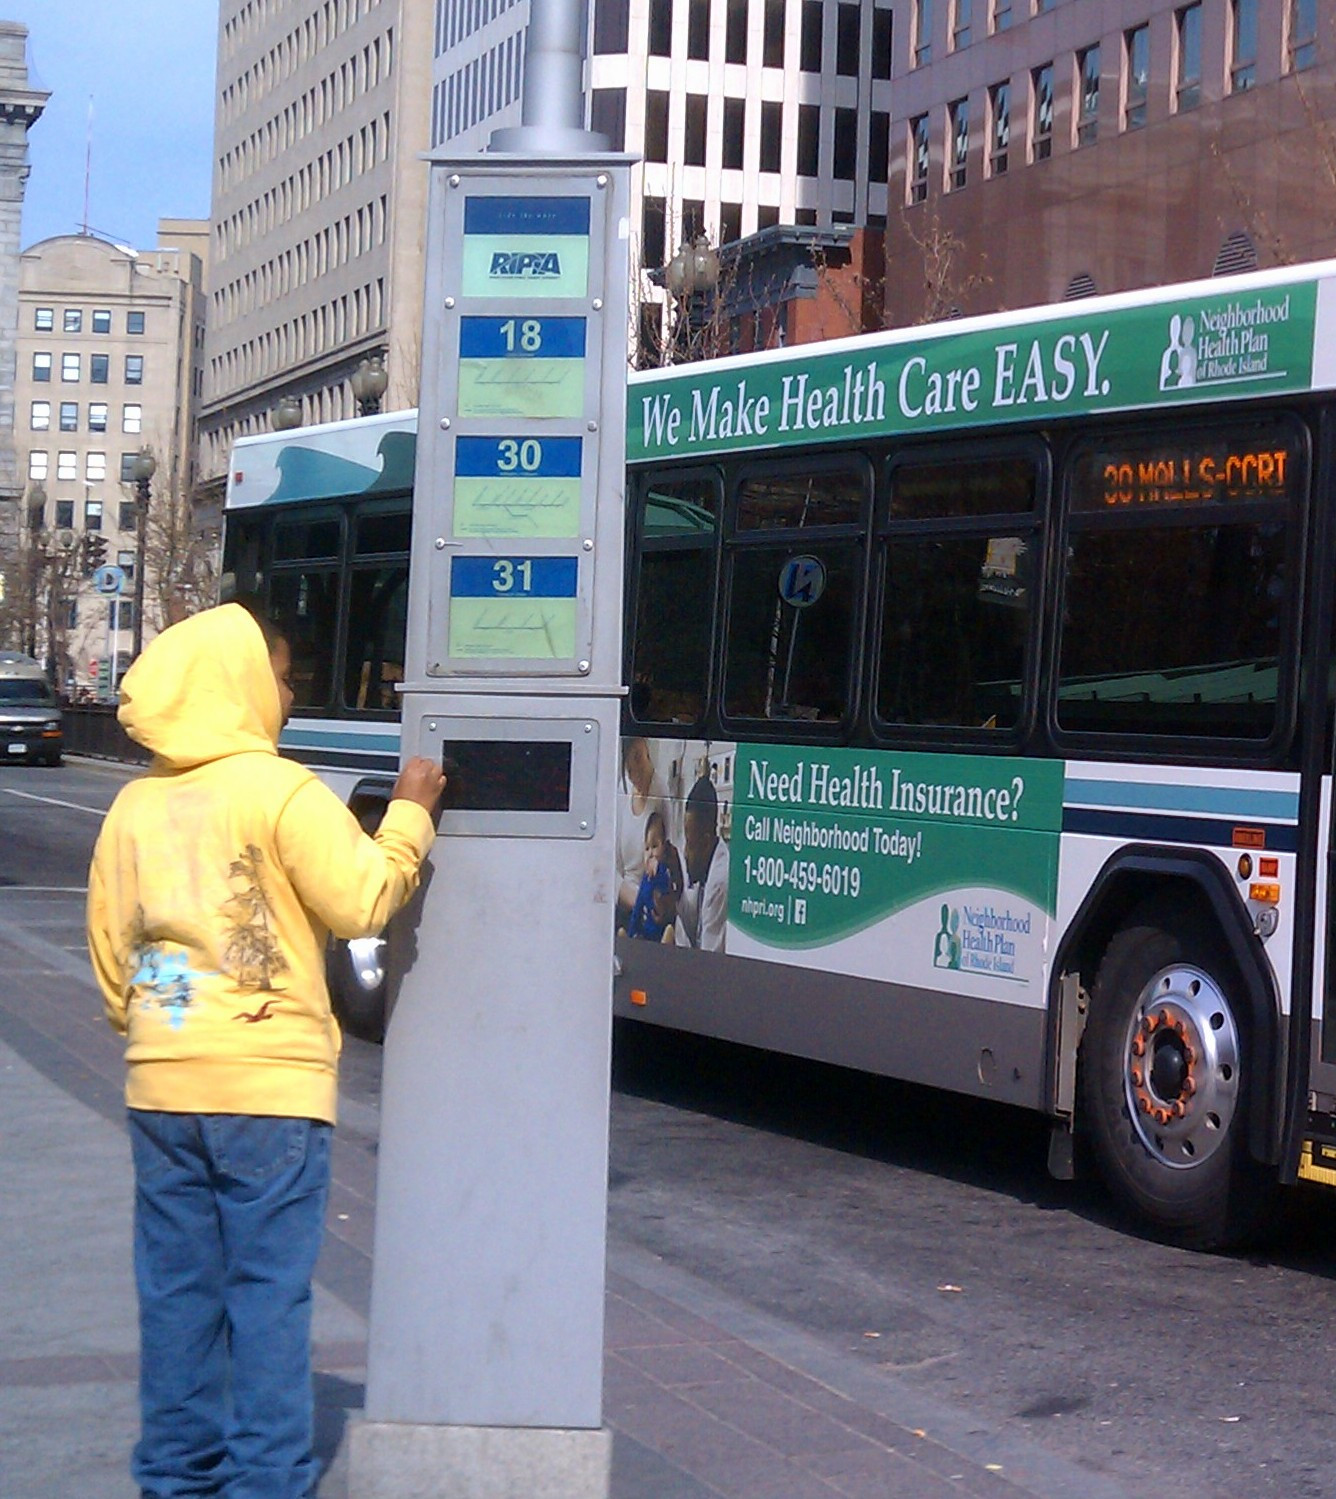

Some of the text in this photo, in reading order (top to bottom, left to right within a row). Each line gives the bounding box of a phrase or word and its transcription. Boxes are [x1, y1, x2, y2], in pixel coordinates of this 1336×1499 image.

[1199, 294, 1290, 337] Neighborhood
[500, 320, 542, 351] 18
[1197, 327, 1269, 360] Health Plan
[1196, 351, 1268, 380] of Rhode Island
[641, 329, 1111, 448] We Make Health Care EASY.
[497, 439, 542, 471] 30
[492, 559, 532, 592] 31
[748, 760, 1025, 822] Need Health Insurance?
[744, 815, 922, 864] Call Neighborhood Today!
[744, 855, 861, 898] 1-800-459-6019
[741, 896, 784, 923] nhpri.org
[963, 905, 1031, 934] Neighborhood
[962, 929, 1015, 956] Health Plan
